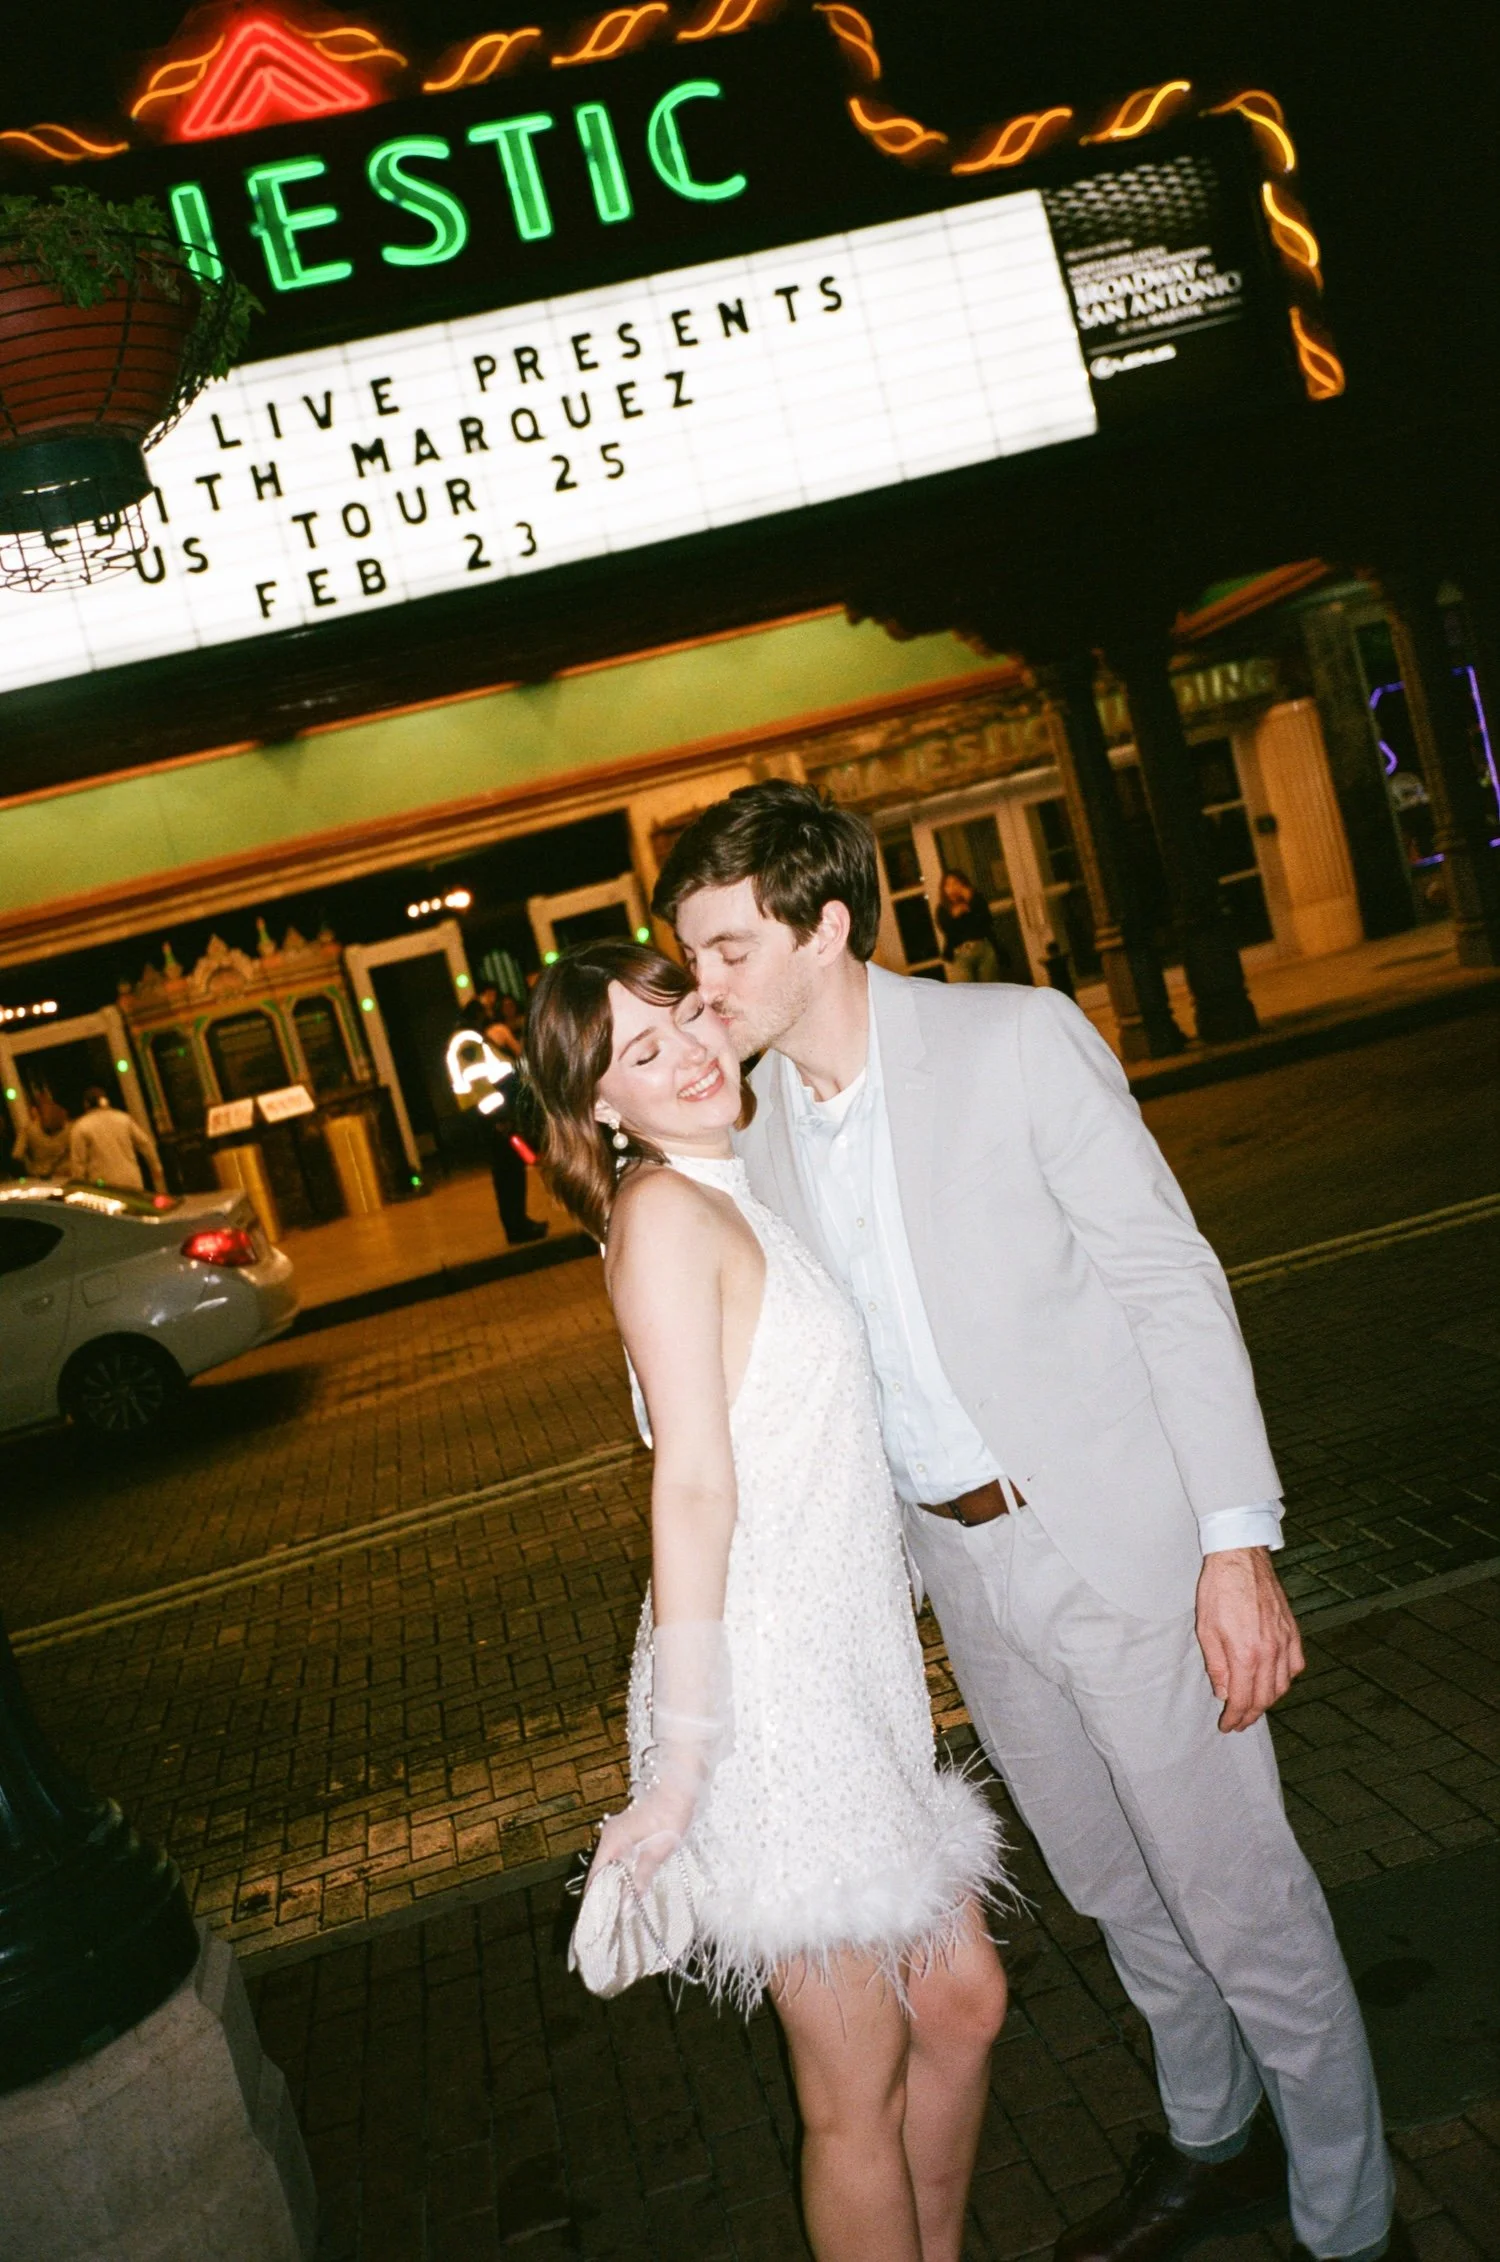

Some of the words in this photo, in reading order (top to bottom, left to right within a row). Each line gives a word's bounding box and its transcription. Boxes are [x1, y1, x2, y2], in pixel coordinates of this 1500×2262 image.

[1077, 300, 1127, 330] SAN
[1130, 270, 1242, 317] ANTONIO
[211, 376, 400, 450] LIVE
[473, 276, 842, 392] PRESENTS
[351, 370, 693, 478] MARQUEZ
[135, 537, 209, 584] US
[291, 478, 476, 549] TOUR
[551, 442, 624, 492] 25
[255, 558, 387, 618] FEB
[464, 522, 537, 571] 23
